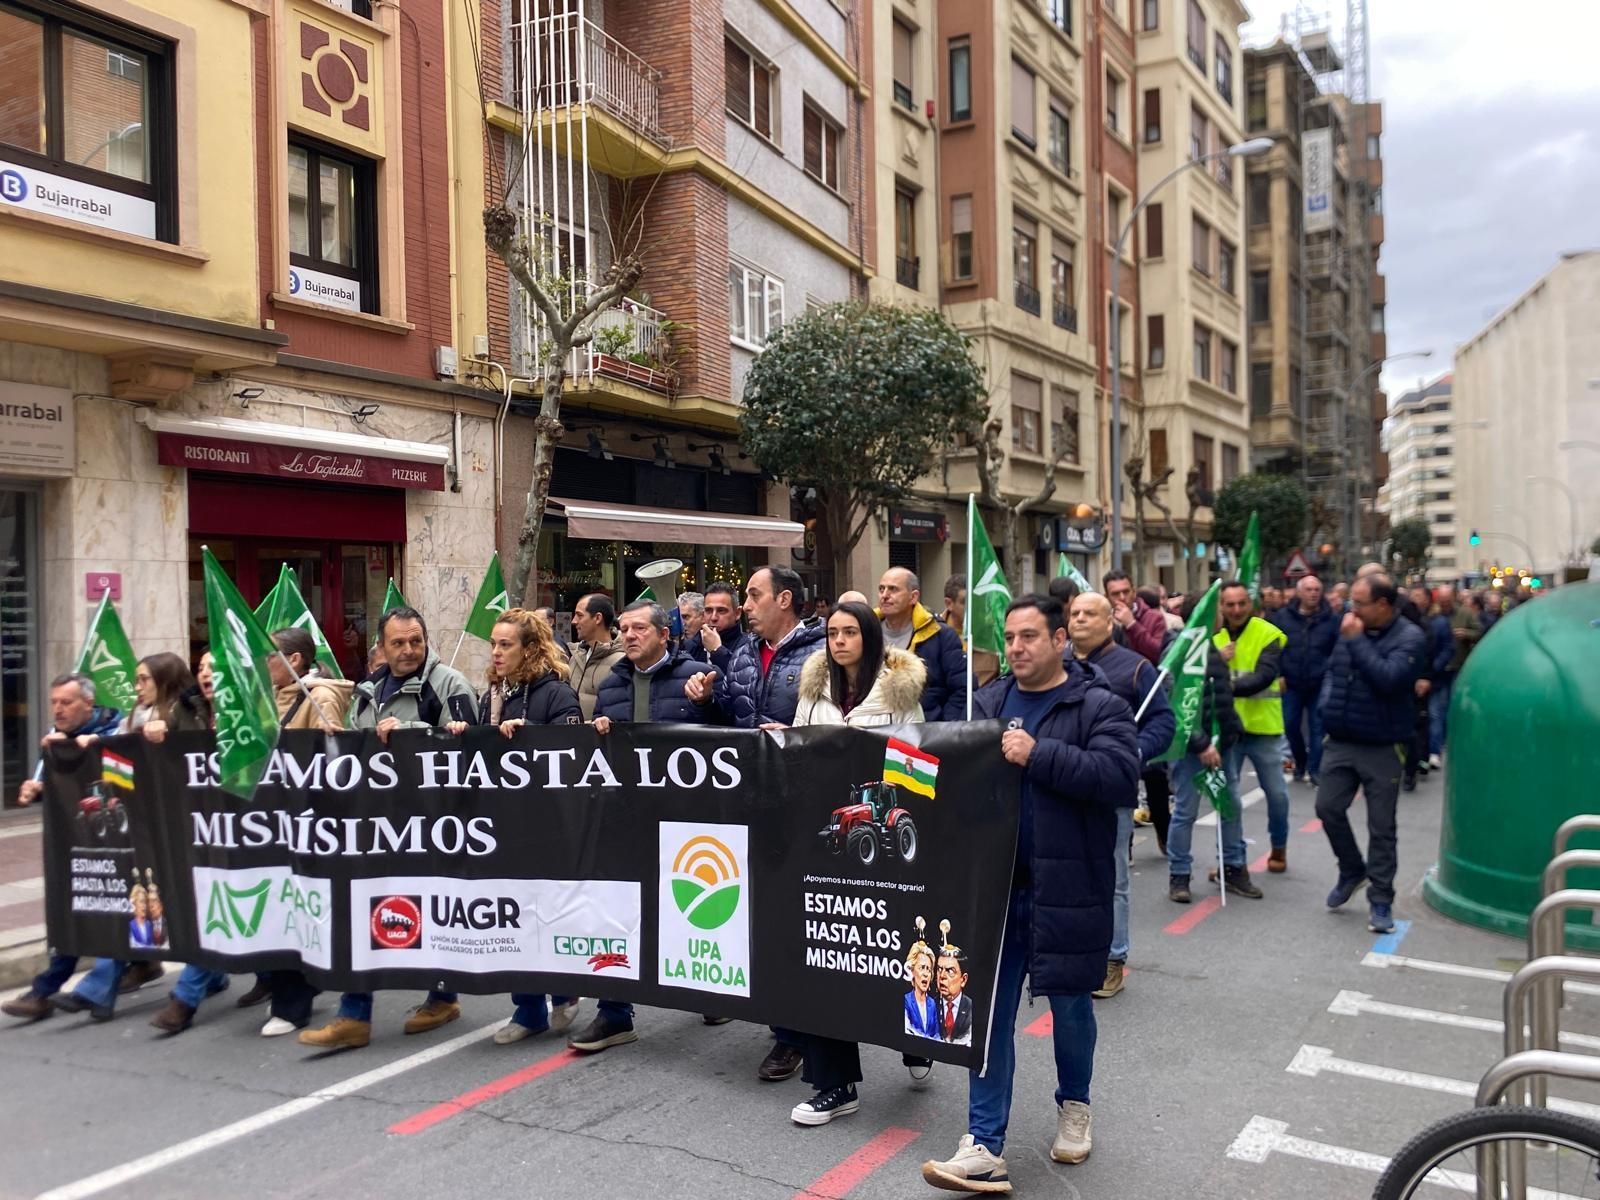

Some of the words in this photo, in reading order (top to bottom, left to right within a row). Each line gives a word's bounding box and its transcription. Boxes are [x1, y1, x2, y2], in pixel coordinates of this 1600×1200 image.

[36, 185, 112, 216] Bujarrabal
[305, 280, 355, 302] Bujarrabal
[184, 445, 250, 464] RISTORANTI
[280, 452, 303, 472] La
[304, 455, 364, 478] Tagliatella
[391, 468, 428, 482] PIZZERIE
[211, 671, 256, 745] ARAG
[415, 748, 622, 789] HASTA
[634, 747, 742, 789] LOS
[71, 858, 117, 873] ESTAMOS
[71, 877, 105, 891] HASTA
[106, 879, 128, 892] LOS
[803, 874, 841, 884] ¡Apoyemos
[846, 878, 875, 887] nuestro
[876, 881, 897, 889] sector
[898, 883, 925, 892] agrario!
[430, 894, 521, 930] UAGR
[804, 892, 888, 920] ESTAMOS
[437, 943, 473, 954] GANADEROS
[474, 947, 485, 955] DE
[486, 946, 497, 954] LA
[499, 945, 521, 953] RIOJA
[452, 937, 460, 945] DE
[460, 937, 516, 946] AGRICULTORES
[554, 936, 626, 957] COAG
[688, 938, 722, 961] UPA
[805, 920, 862, 946] HASTA
[866, 926, 901, 951] LOS
[665, 958, 687, 979] LA
[692, 961, 747, 987] RIOJA
[806, 946, 913, 982] MISMÍSIMOS
